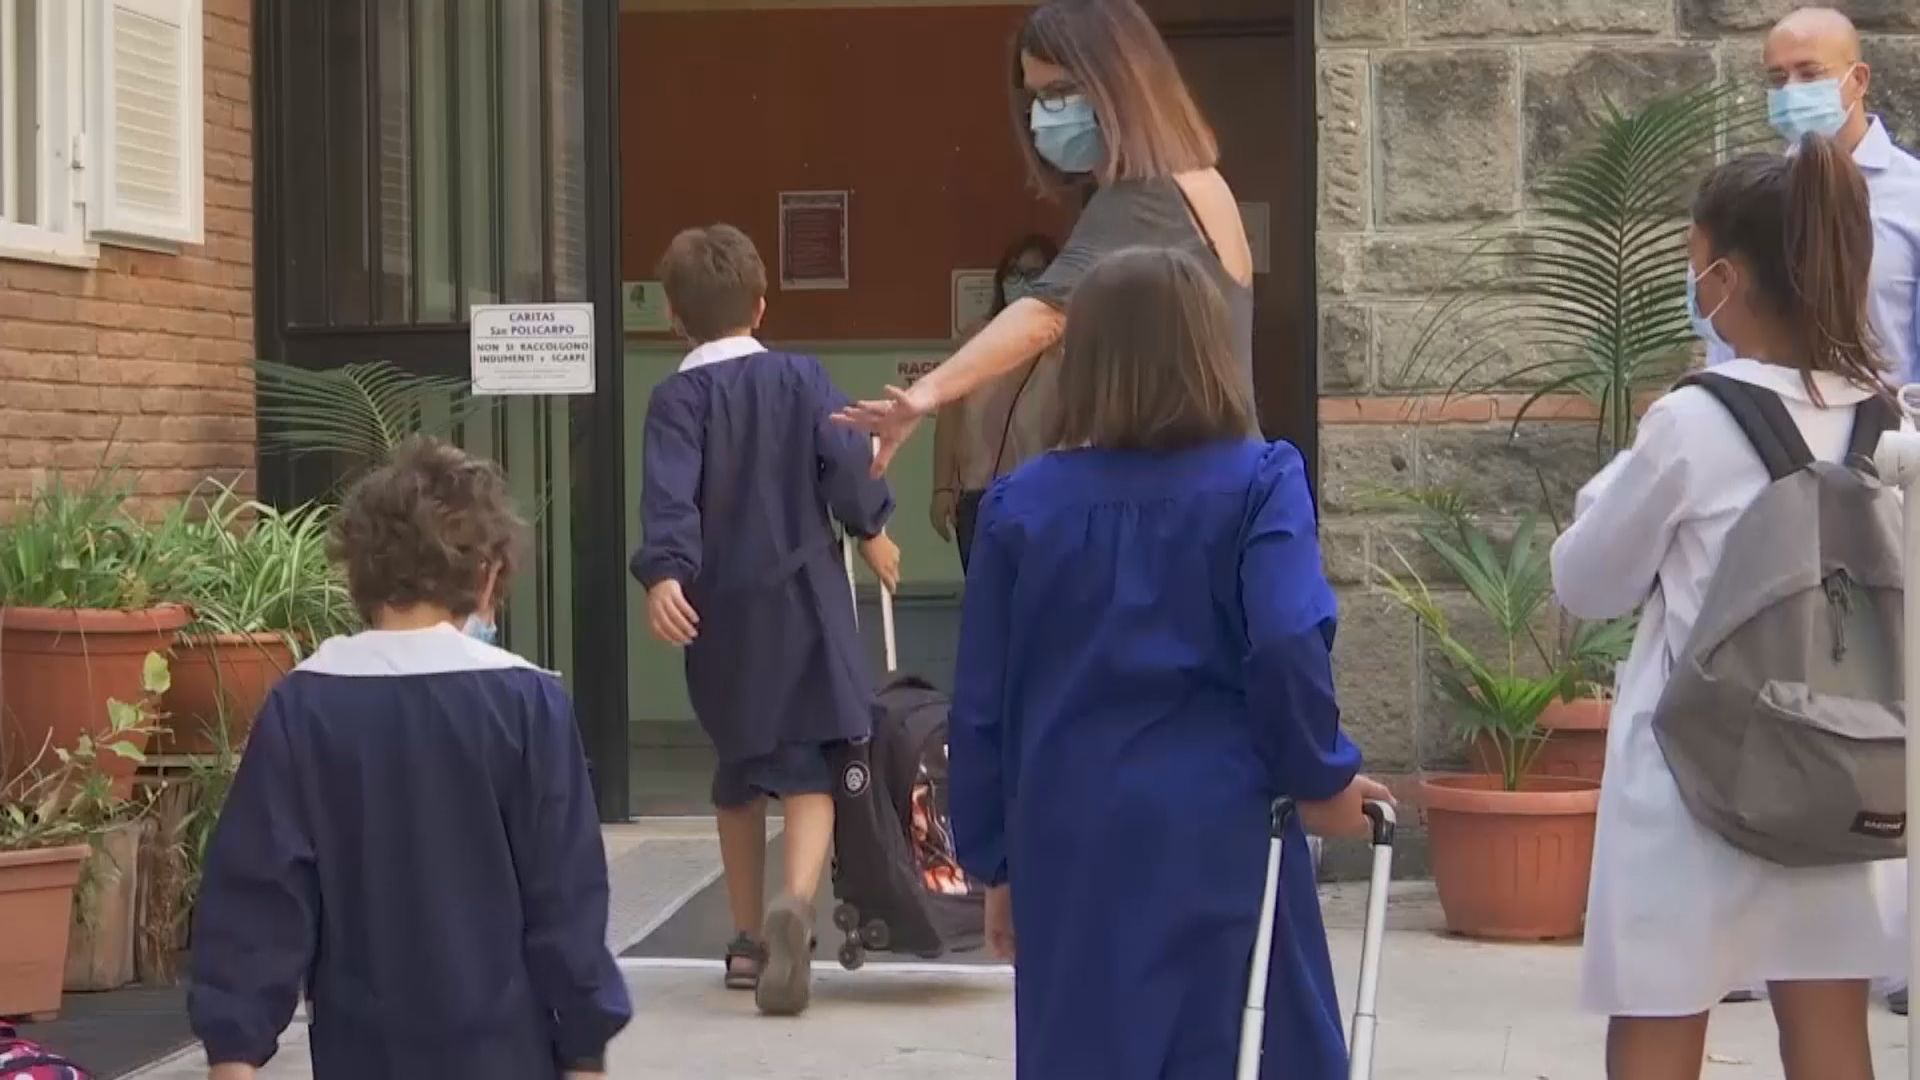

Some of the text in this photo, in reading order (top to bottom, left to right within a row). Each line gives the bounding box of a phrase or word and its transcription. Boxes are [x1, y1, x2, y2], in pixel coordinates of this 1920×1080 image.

[509, 312, 555, 321] CARITAS
[511, 325, 574, 335] POLICARPO
[477, 342, 588, 351] NON SI RACCOLGONO
[479, 354, 534, 363] INDUMENTI
